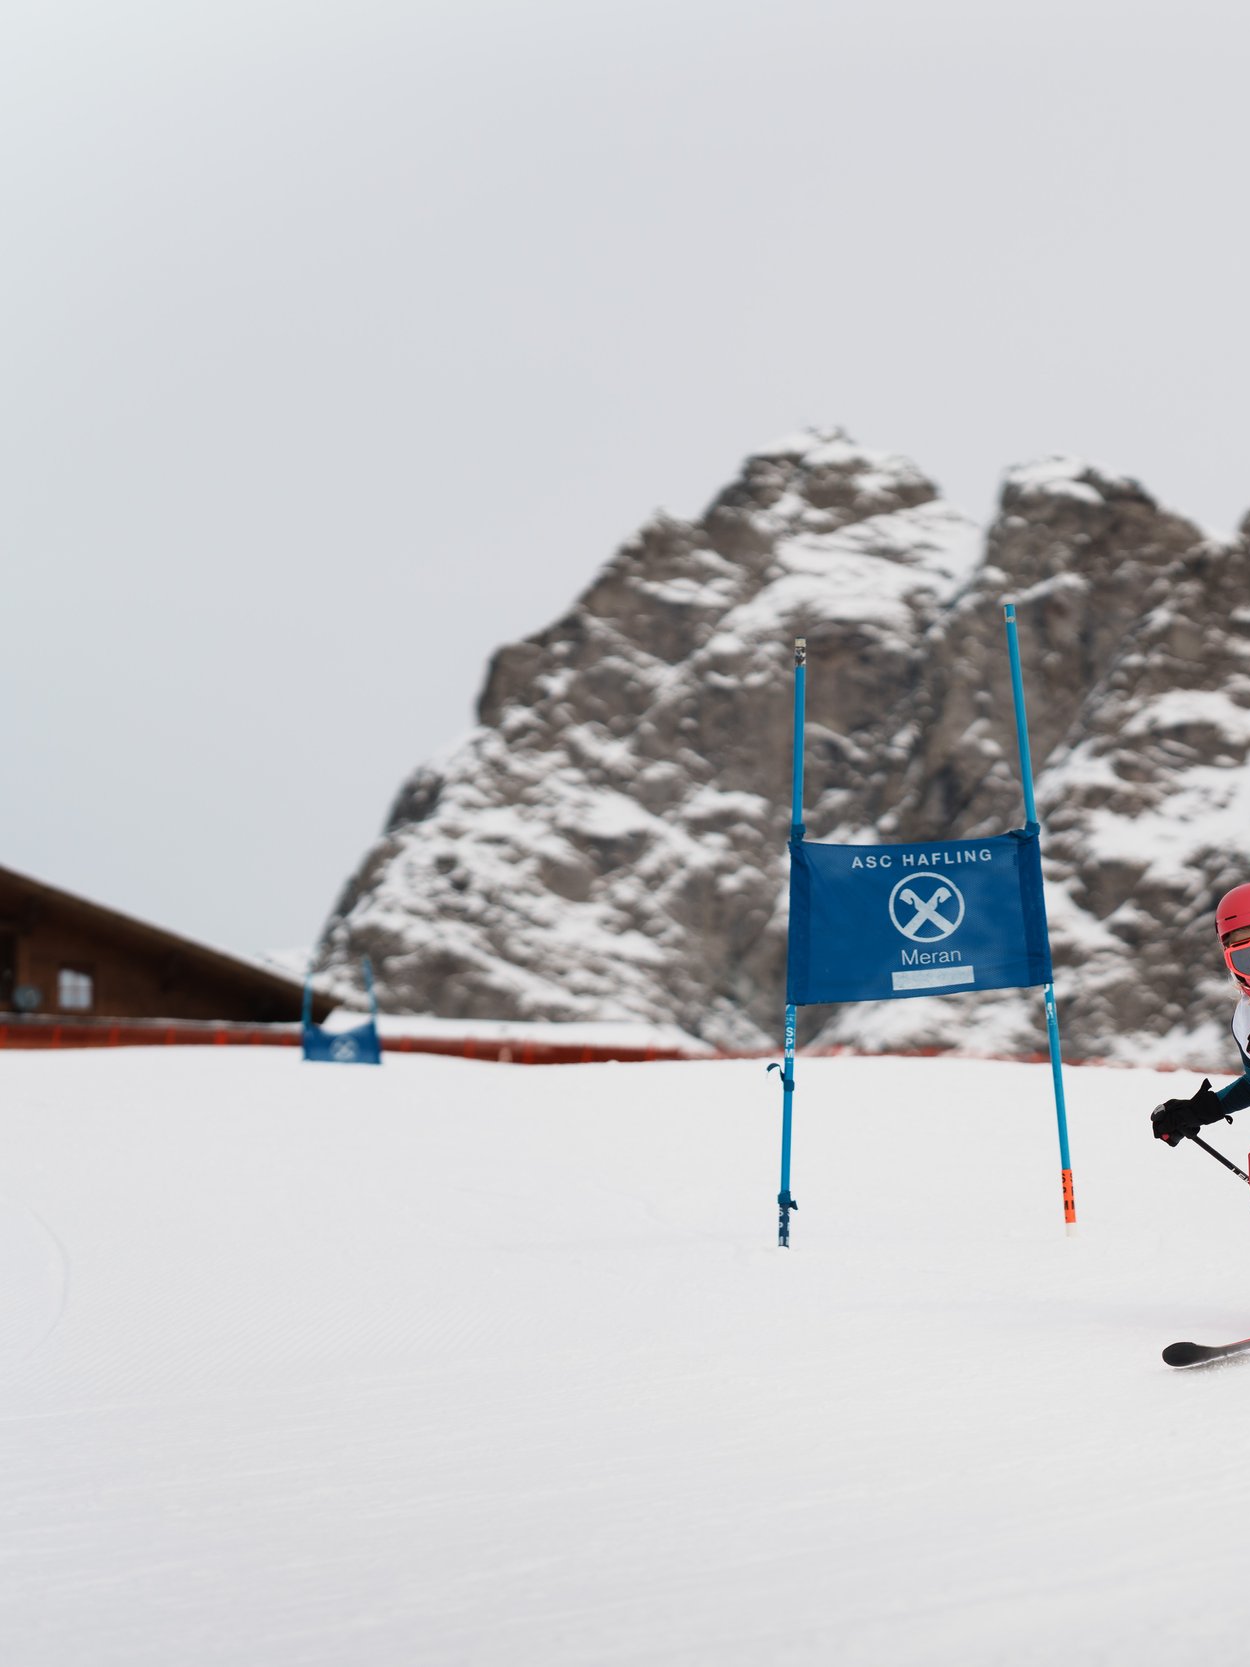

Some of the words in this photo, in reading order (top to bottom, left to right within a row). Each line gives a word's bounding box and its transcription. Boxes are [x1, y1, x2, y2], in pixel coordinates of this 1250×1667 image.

[851, 854, 892, 869] ASC
[902, 848, 992, 867] HAFLING
[901, 949, 962, 965] Meran
